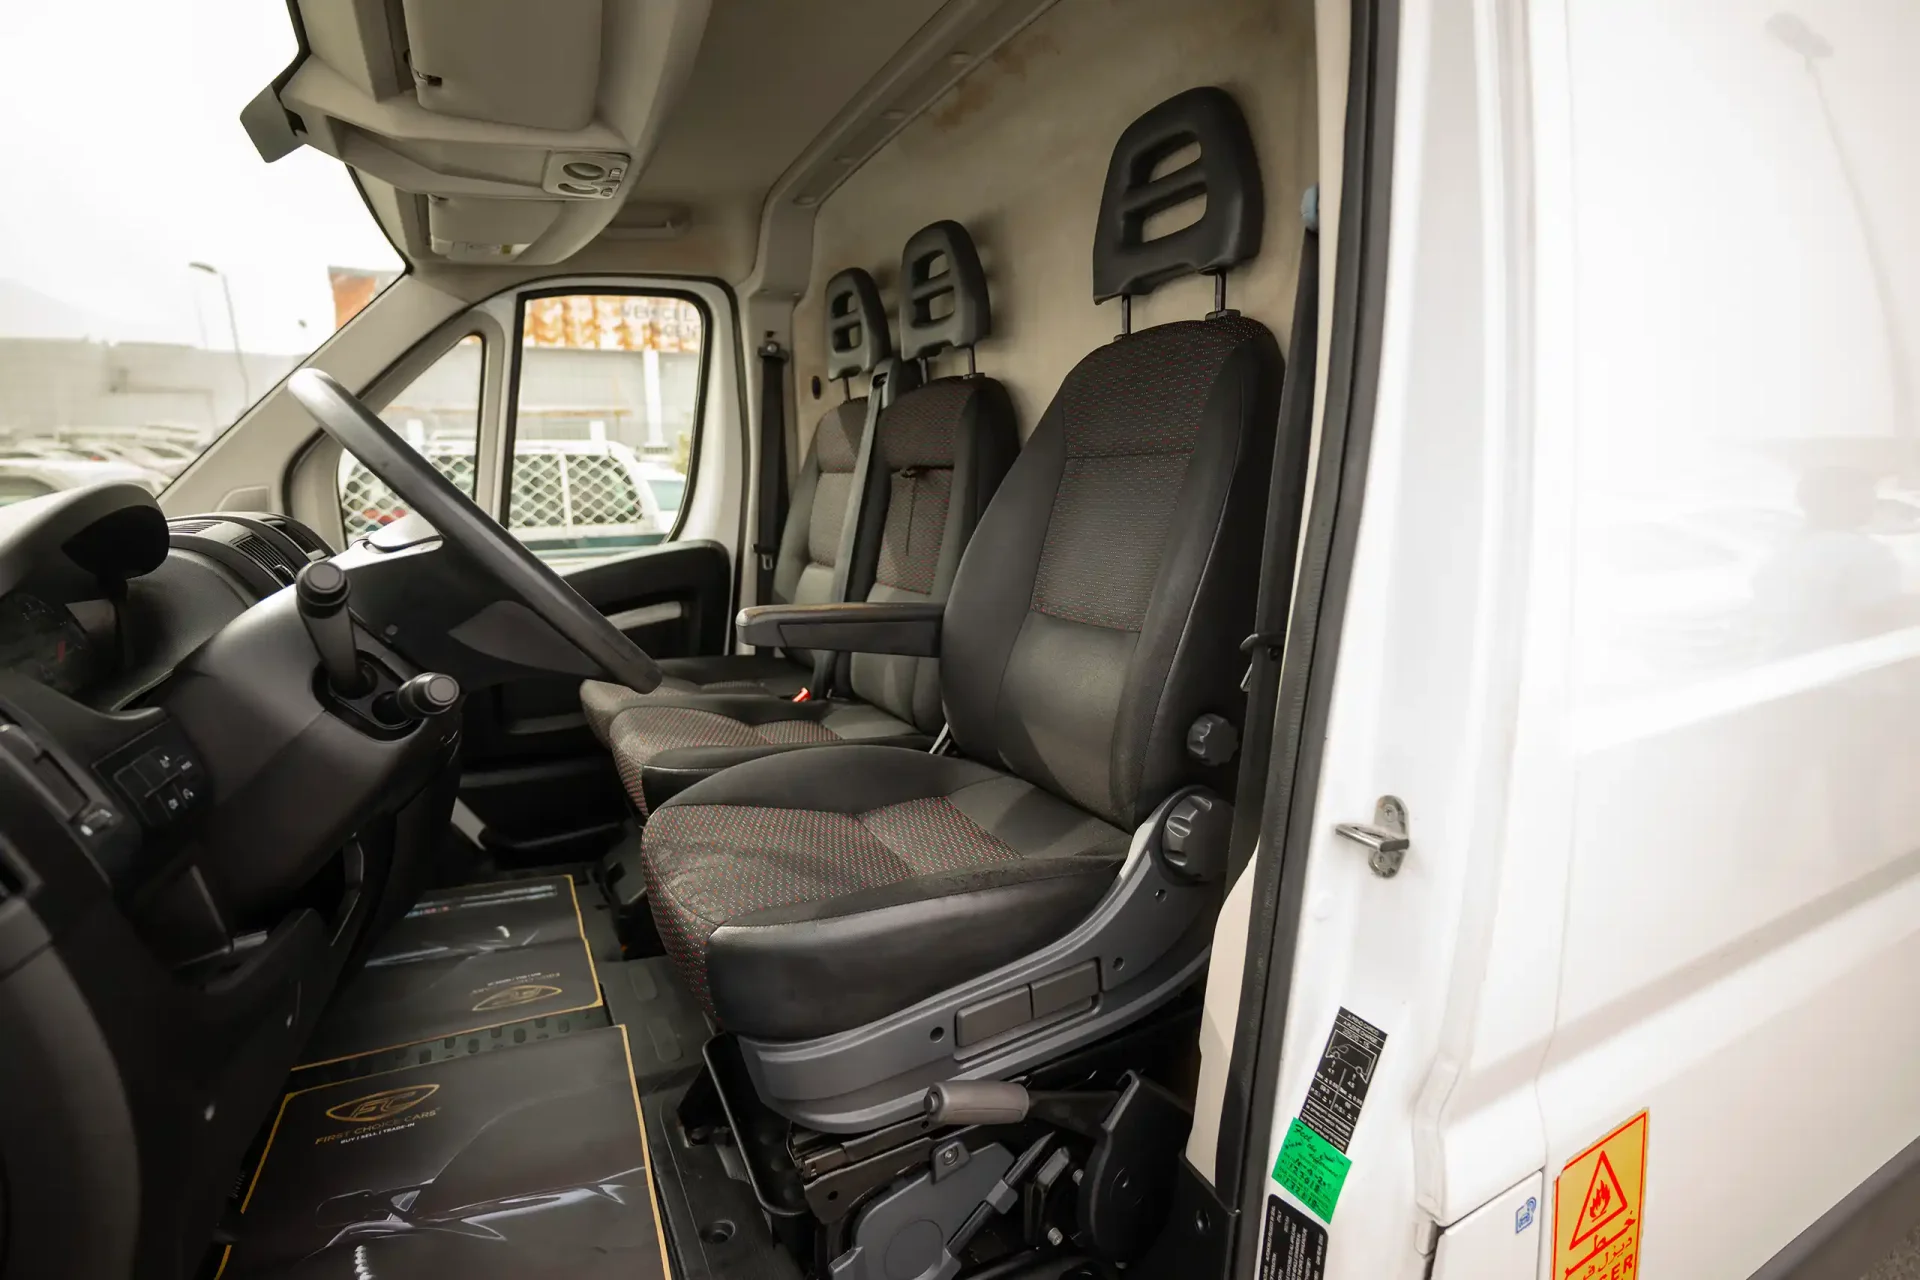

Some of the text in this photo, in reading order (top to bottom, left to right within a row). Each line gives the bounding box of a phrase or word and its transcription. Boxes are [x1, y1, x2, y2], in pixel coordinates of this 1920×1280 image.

[314, 1131, 350, 1145] FIRST
[353, 1120, 401, 1135] CHOICE
[361, 1131, 378, 1139] SELL
[383, 1122, 415, 1133] TRADE-IN
